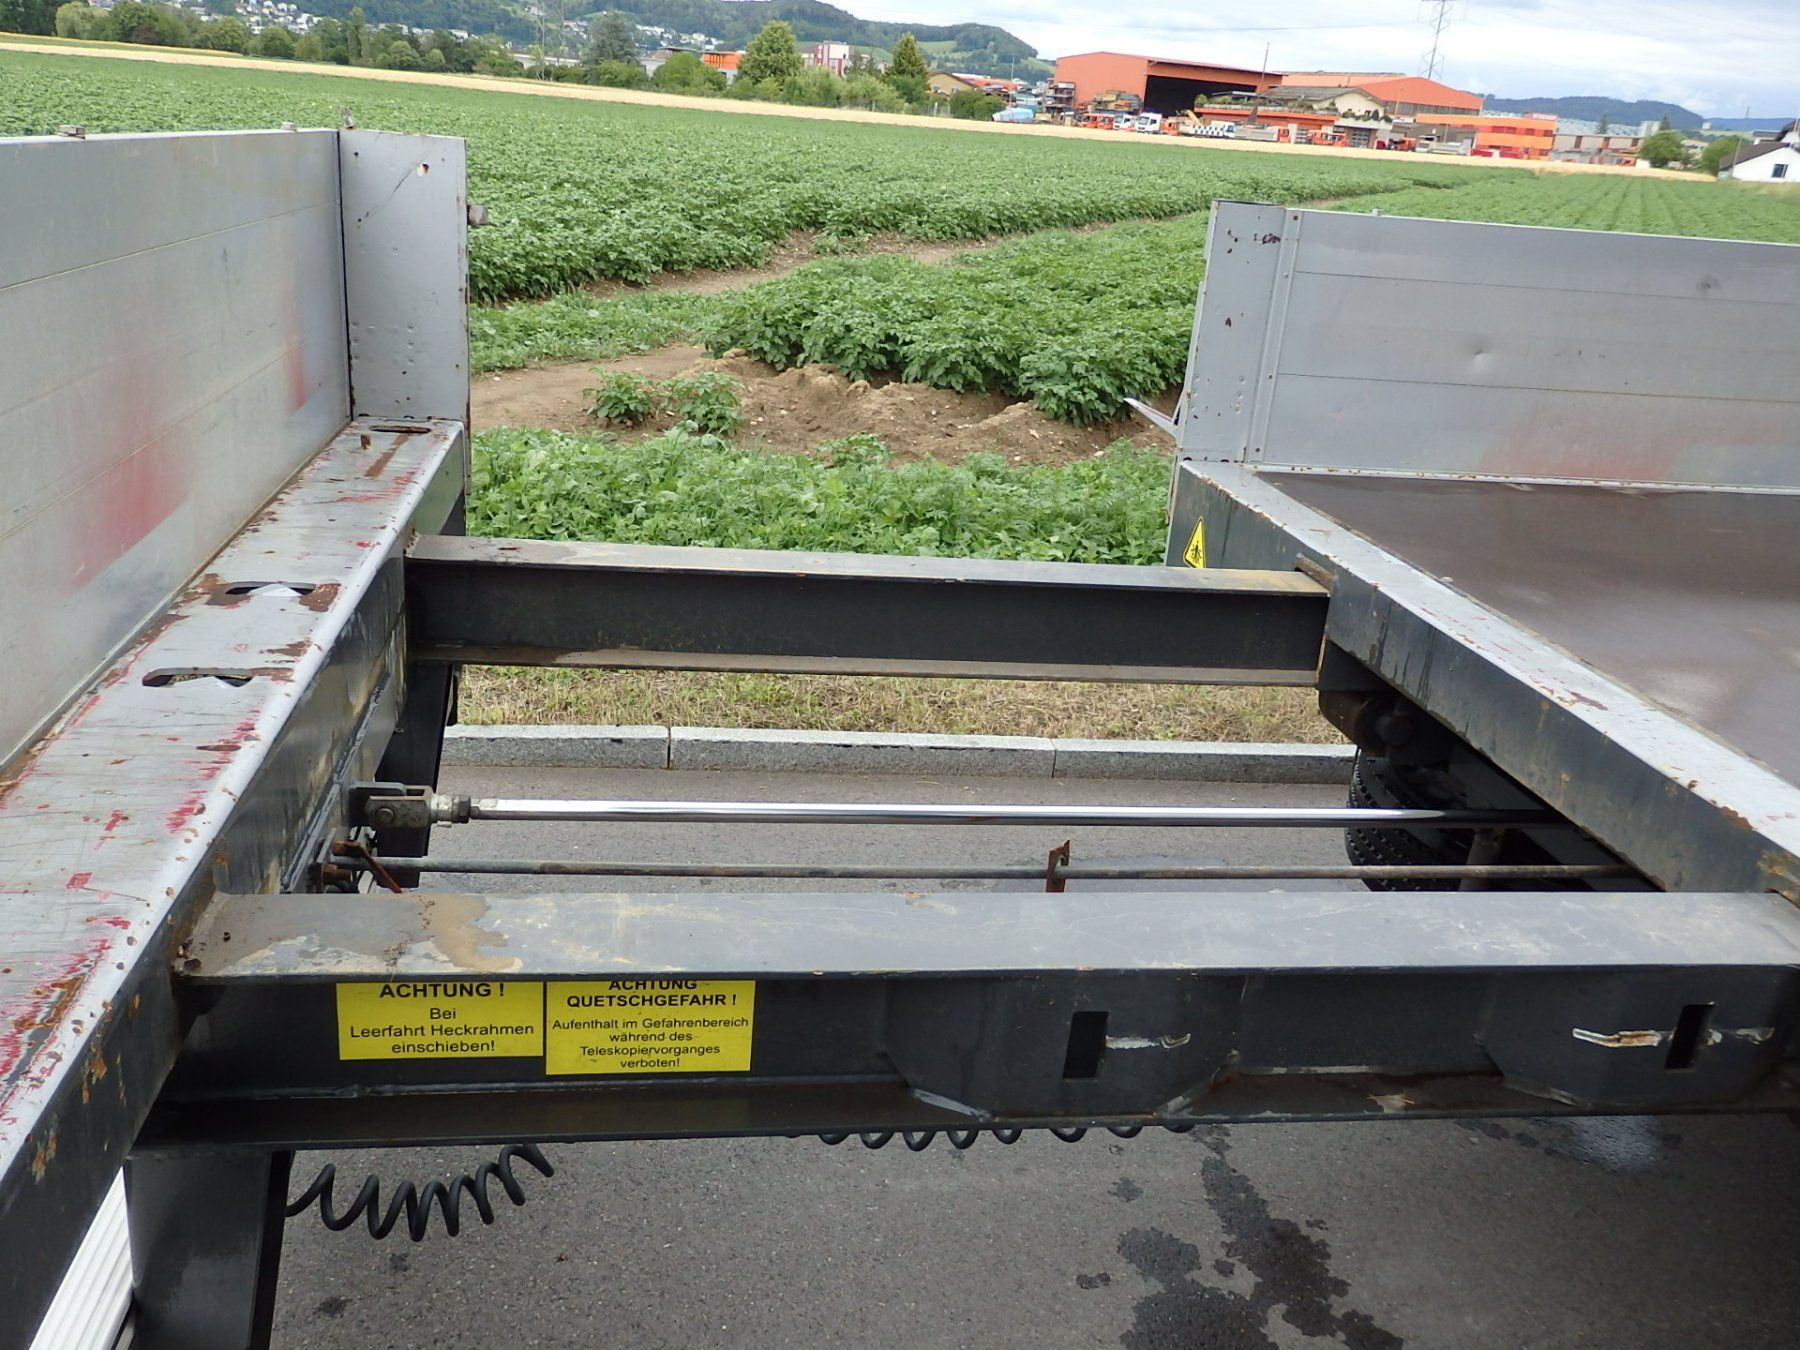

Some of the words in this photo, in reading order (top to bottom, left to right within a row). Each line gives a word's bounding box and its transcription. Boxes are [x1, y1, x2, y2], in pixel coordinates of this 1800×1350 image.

[379, 983, 492, 998] ACHTUNG
[567, 994, 727, 1008] QUETSCHGEFAHR
[430, 1007, 457, 1020] Bei
[351, 1025, 426, 1038] Leerfahrt
[431, 1023, 534, 1036] Heckrahmen
[552, 1018, 619, 1030] Aufenthalt
[623, 1018, 638, 1029] im
[642, 1017, 749, 1029] Gefahrenbereich
[609, 1031, 665, 1042] während
[669, 1031, 693, 1042] des
[391, 1040, 495, 1054] einschieben!
[580, 1044, 721, 1058] Teleskopiervorganges
[620, 1057, 680, 1068] verboten!
